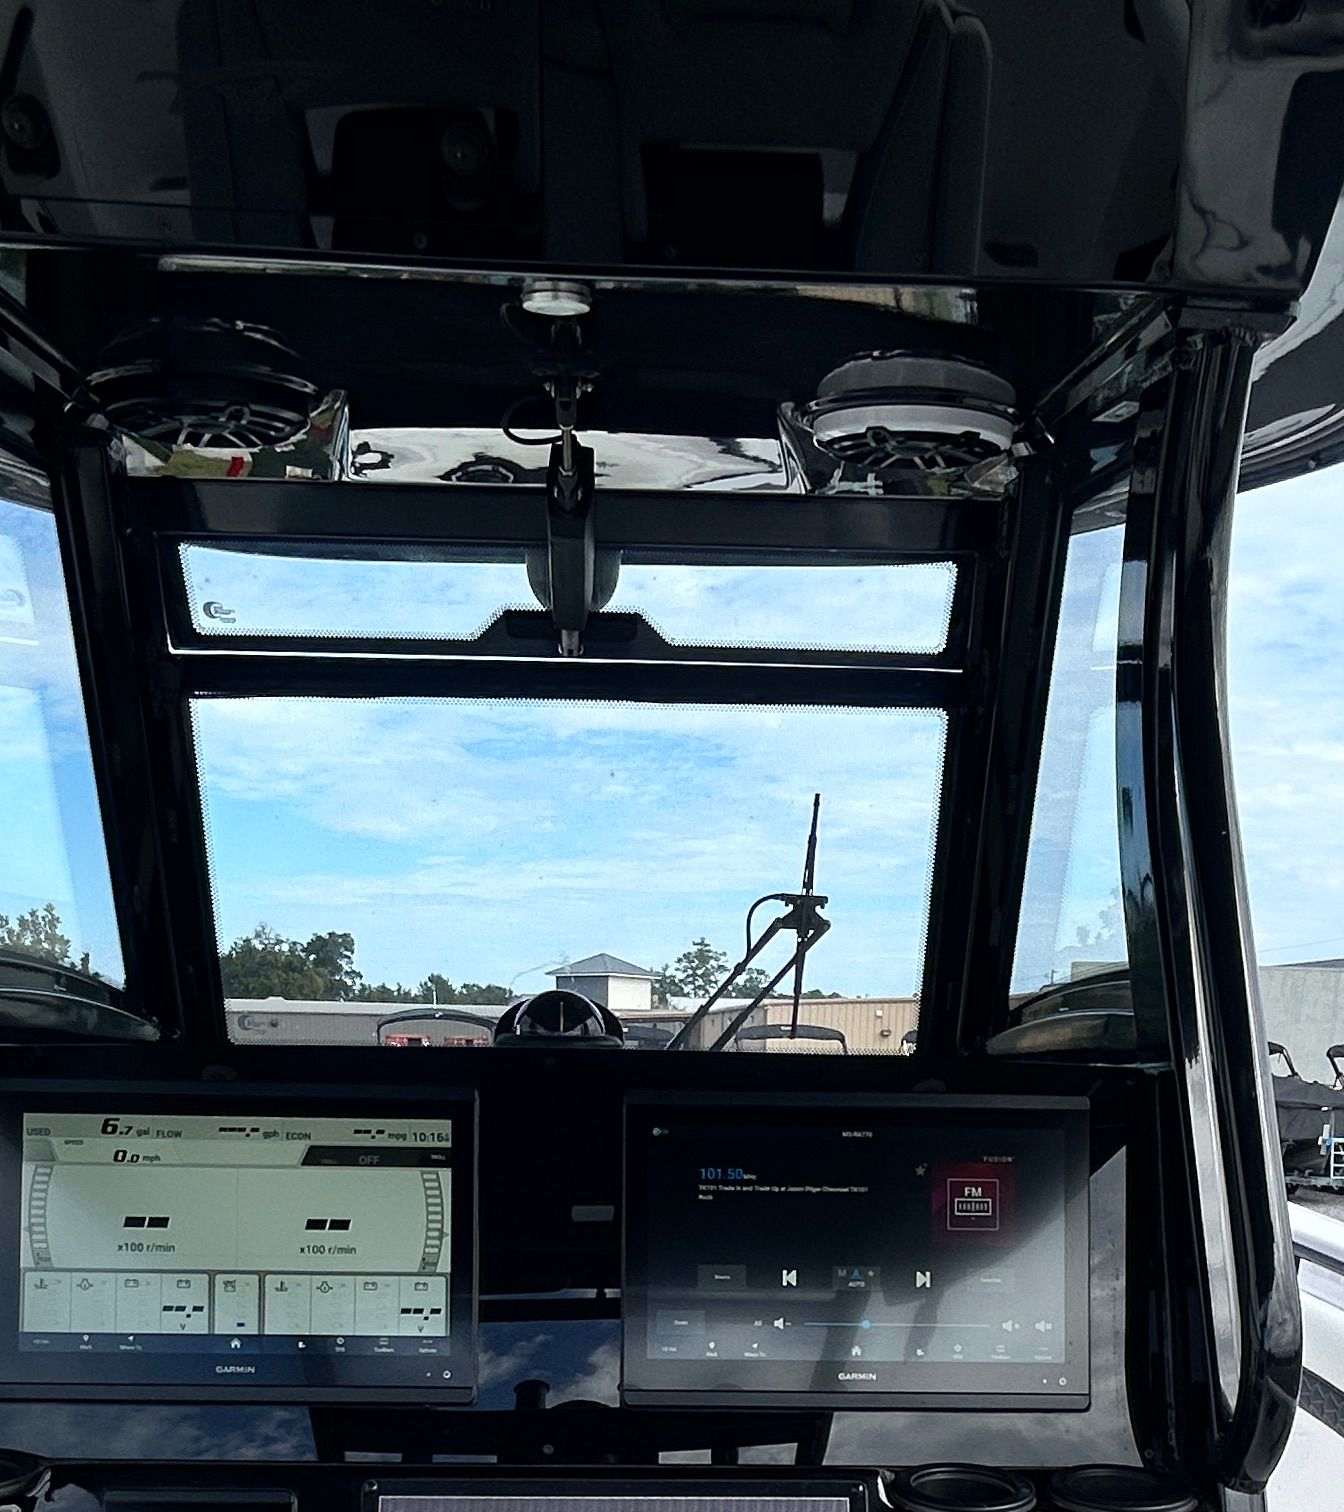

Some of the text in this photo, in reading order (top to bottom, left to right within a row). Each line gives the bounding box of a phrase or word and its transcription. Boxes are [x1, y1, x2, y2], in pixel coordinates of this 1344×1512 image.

[26, 1127, 52, 1137] USED
[101, 1117, 134, 1136] 6.7
[136, 1127, 150, 1137] gal
[156, 1129, 183, 1139] FLOW
[262, 1129, 280, 1140] gph
[285, 1132, 312, 1141] ECON
[388, 1132, 408, 1143] mpg
[113, 1149, 161, 1163] 0.0 mph
[358, 1155, 380, 1165] OFF
[964, 1186, 982, 1197] FM
[117, 1241, 176, 1254] x100 r/min
[299, 1243, 356, 1256] x100 r/min
[215, 1365, 255, 1374] GARMIN
[838, 1372, 877, 1381] GARMIN
